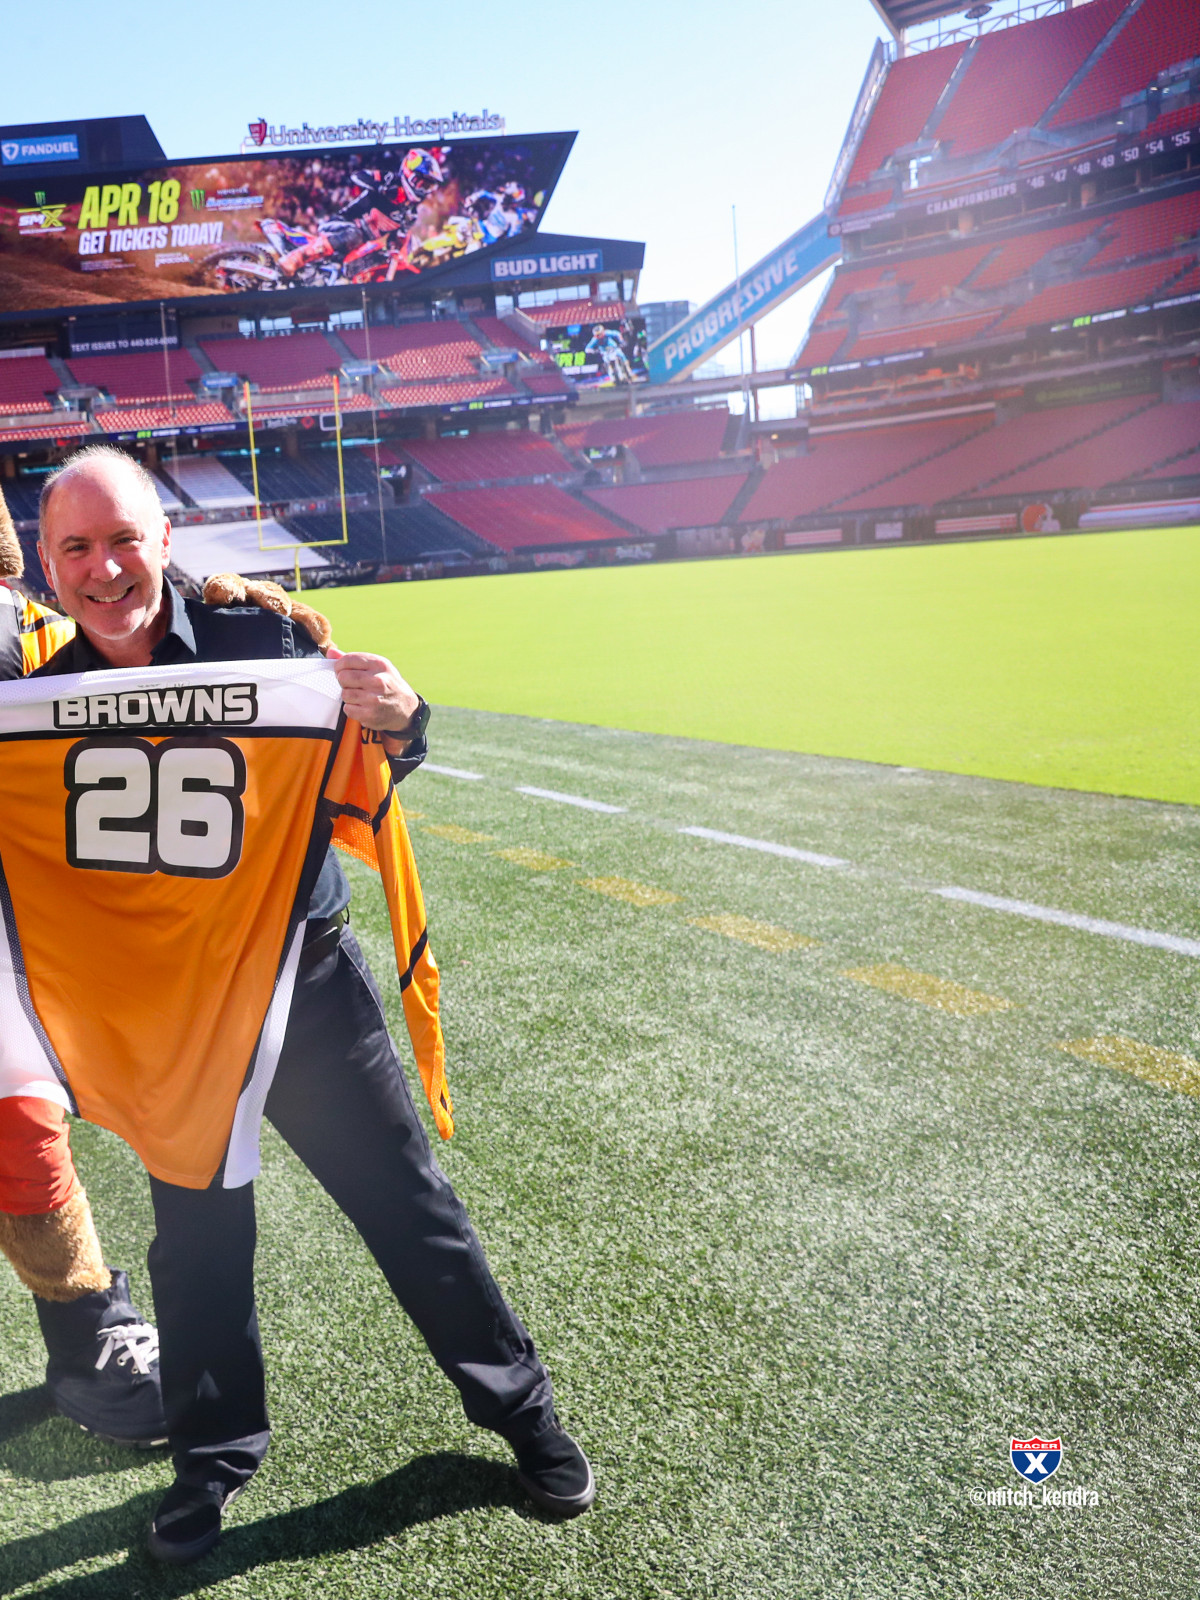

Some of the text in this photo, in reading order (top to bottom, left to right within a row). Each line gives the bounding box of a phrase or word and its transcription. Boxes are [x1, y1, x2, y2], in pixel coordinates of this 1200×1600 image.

[270, 109, 501, 145] University Hospitals
[21, 141, 78, 156] FANDUEL
[77, 183, 142, 230] APR
[148, 179, 181, 224] 18
[926, 181, 1017, 216] CHAMPIONSHIPS
[18, 209, 64, 228] SMX
[78, 221, 224, 256] GET TICKETS TODAY!
[494, 252, 599, 278] BUD LIGHT
[663, 247, 798, 370] PROGRESSIVE
[71, 342, 90, 352] TEXT
[91, 340, 117, 351] ISSUES
[117, 339, 129, 348] TO
[55, 684, 256, 728] BROWNS
[67, 740, 242, 875] 26
